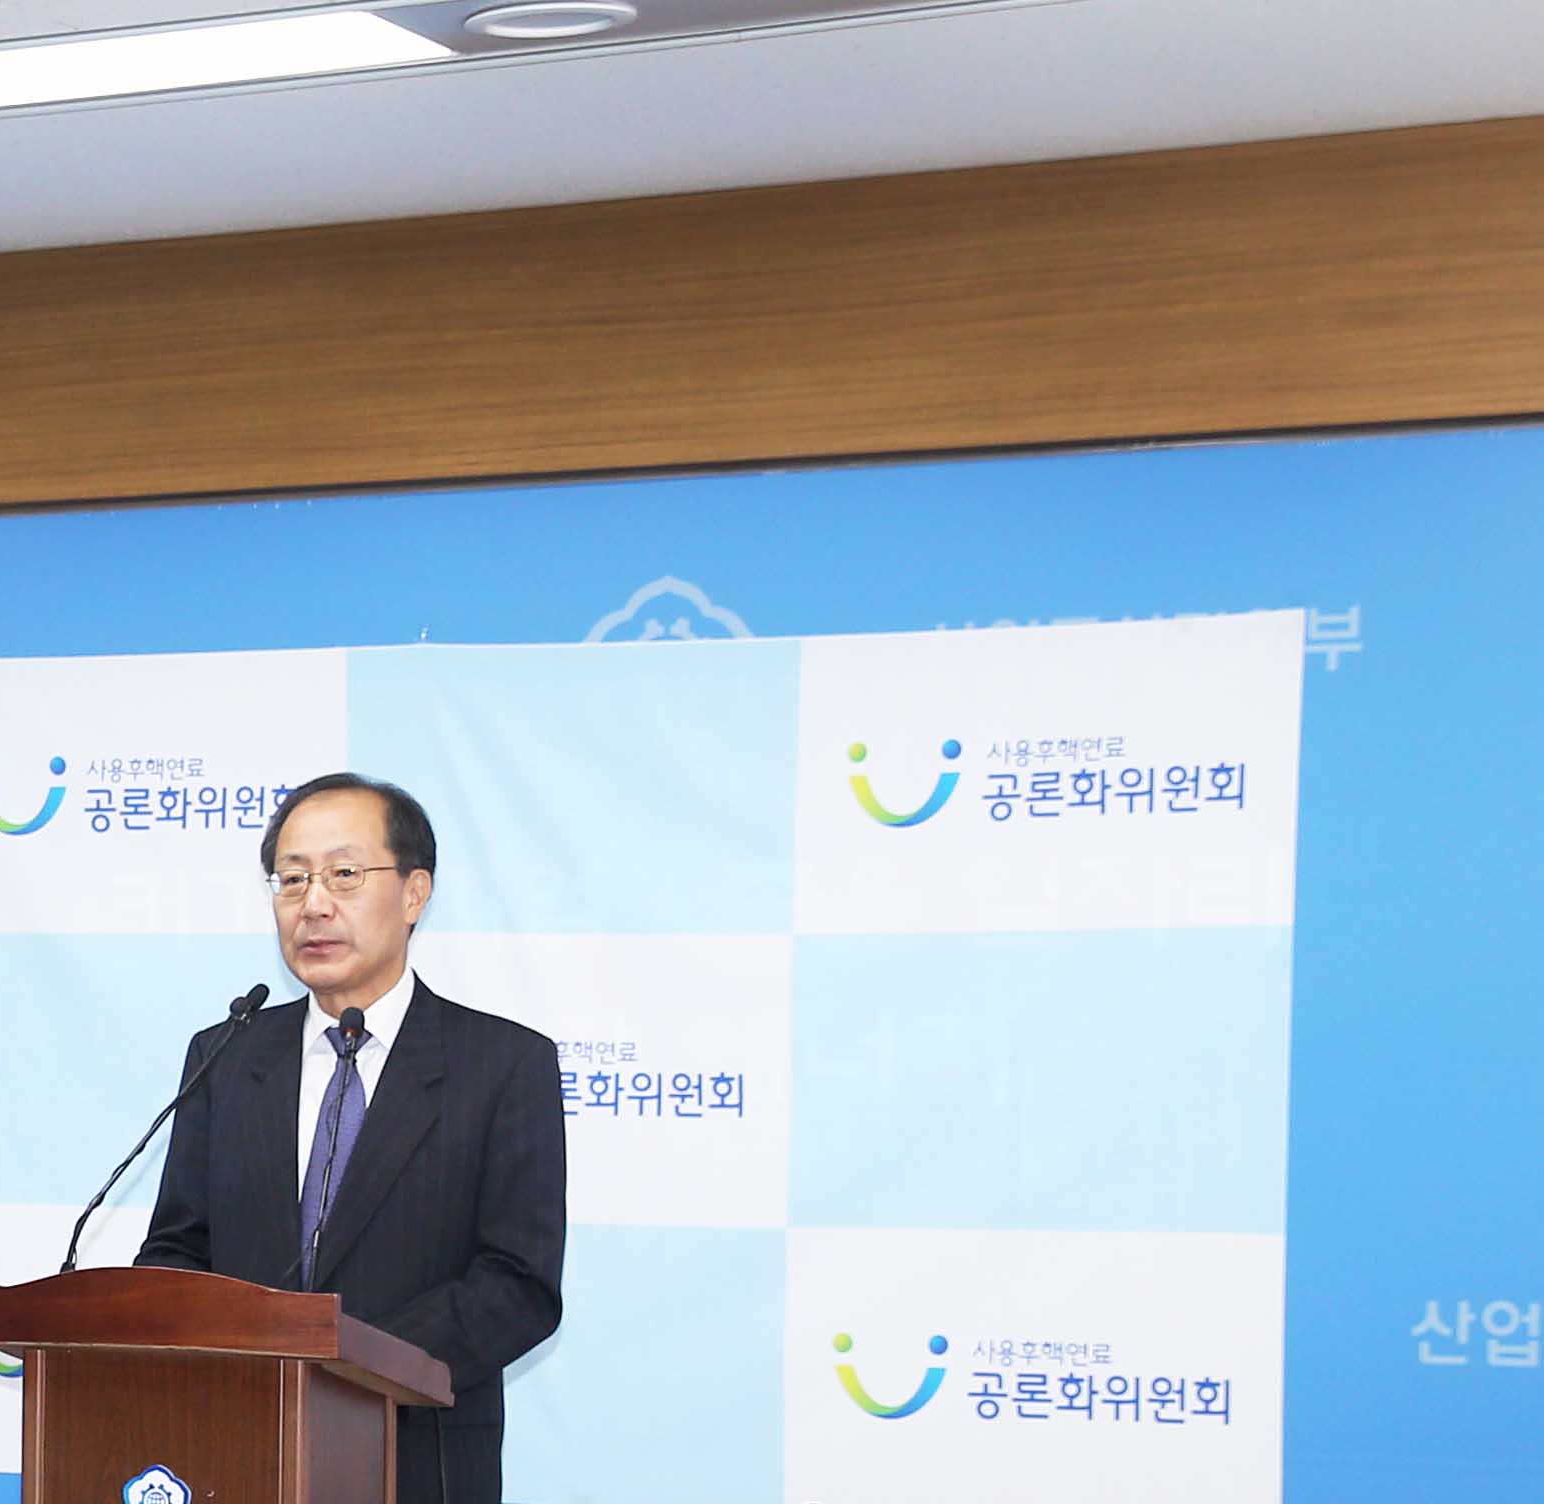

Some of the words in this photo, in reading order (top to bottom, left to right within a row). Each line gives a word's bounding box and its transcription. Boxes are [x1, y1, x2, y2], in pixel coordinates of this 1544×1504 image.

[87, 758, 205, 784] 사용후핵연료
[987, 736, 1126, 768] 사용후핵연료
[982, 763, 1245, 822] 공론화위원회
[973, 1339, 1114, 1367] 사용후핵연료
[1410, 1300, 1541, 1367] 산업
[967, 1372, 1230, 1425] 공론화위원회
